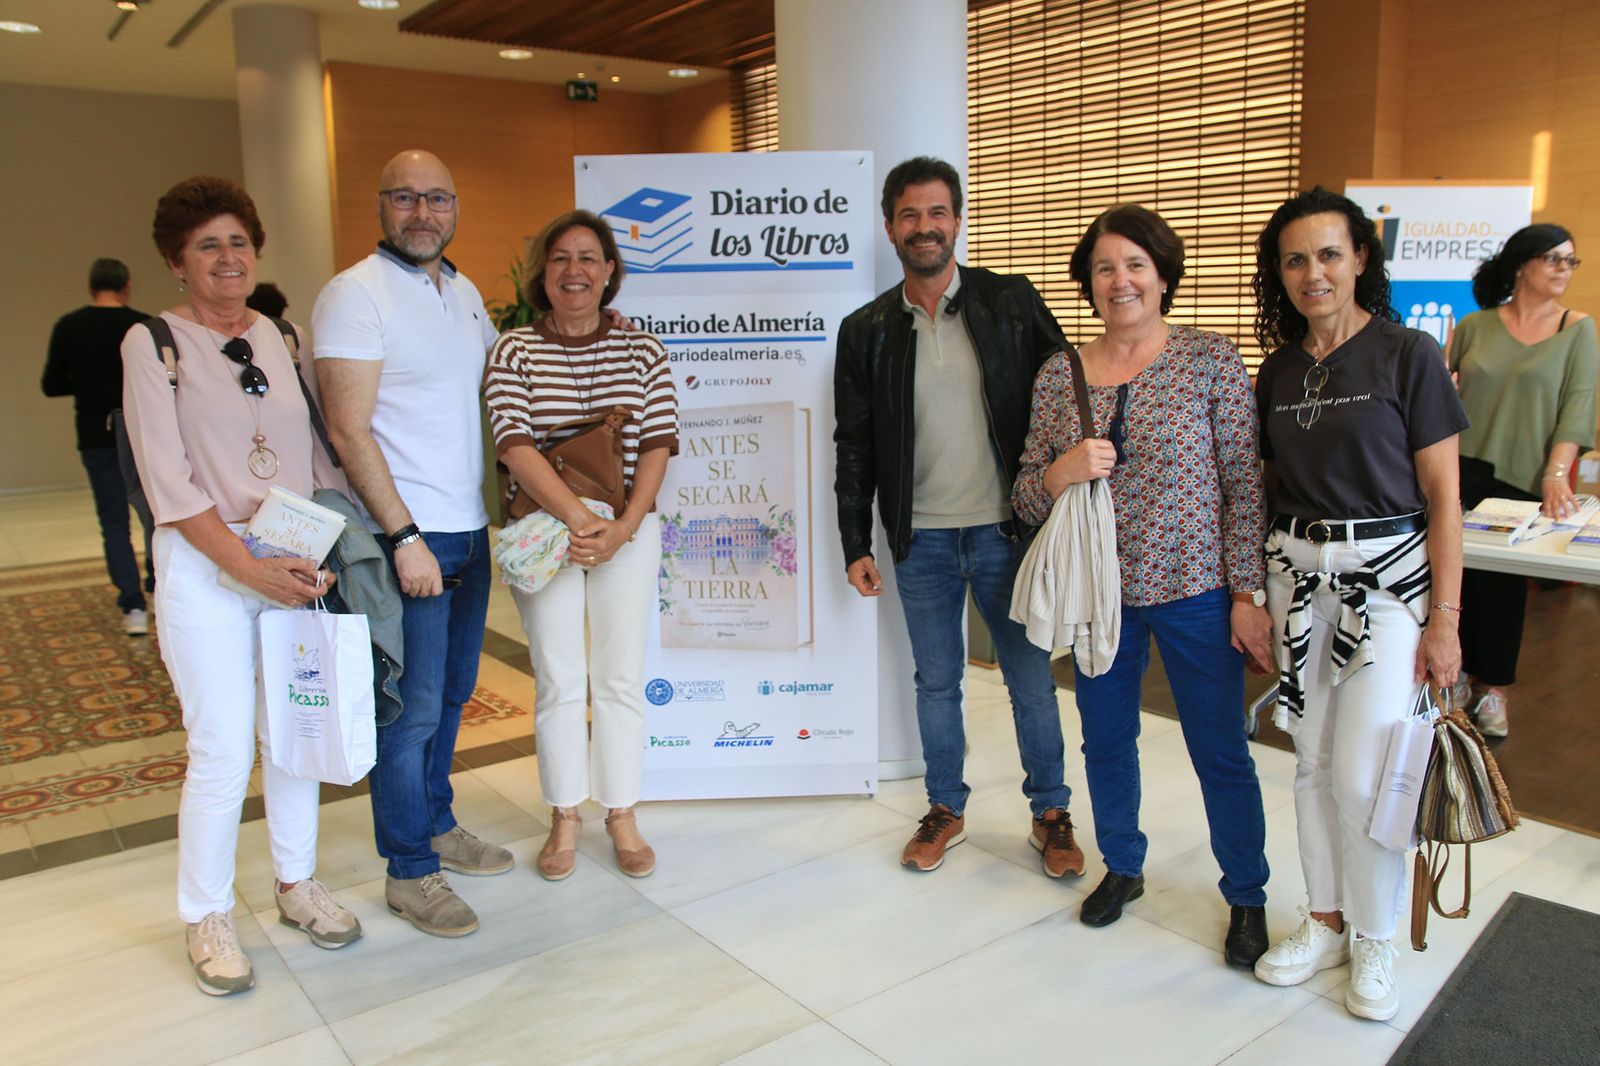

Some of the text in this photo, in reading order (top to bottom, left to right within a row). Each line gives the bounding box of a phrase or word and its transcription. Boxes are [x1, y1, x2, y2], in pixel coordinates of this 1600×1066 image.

[710, 187, 849, 216] Diario de
[1404, 223, 1493, 238] IGUALDAD
[710, 225, 850, 265] los Libros
[703, 313, 730, 334] de
[733, 311, 825, 333] Almería
[1352, 393, 1371, 402] vrai
[685, 432, 760, 458] ANTES
[708, 459, 736, 481] SE
[677, 477, 769, 507] SECARÁ
[711, 556, 739, 576] LA
[683, 579, 769, 600] TIERRA
[778, 681, 834, 696] cajamar
[649, 735, 691, 748] Picasso
[713, 739, 774, 748] MICHELIN
